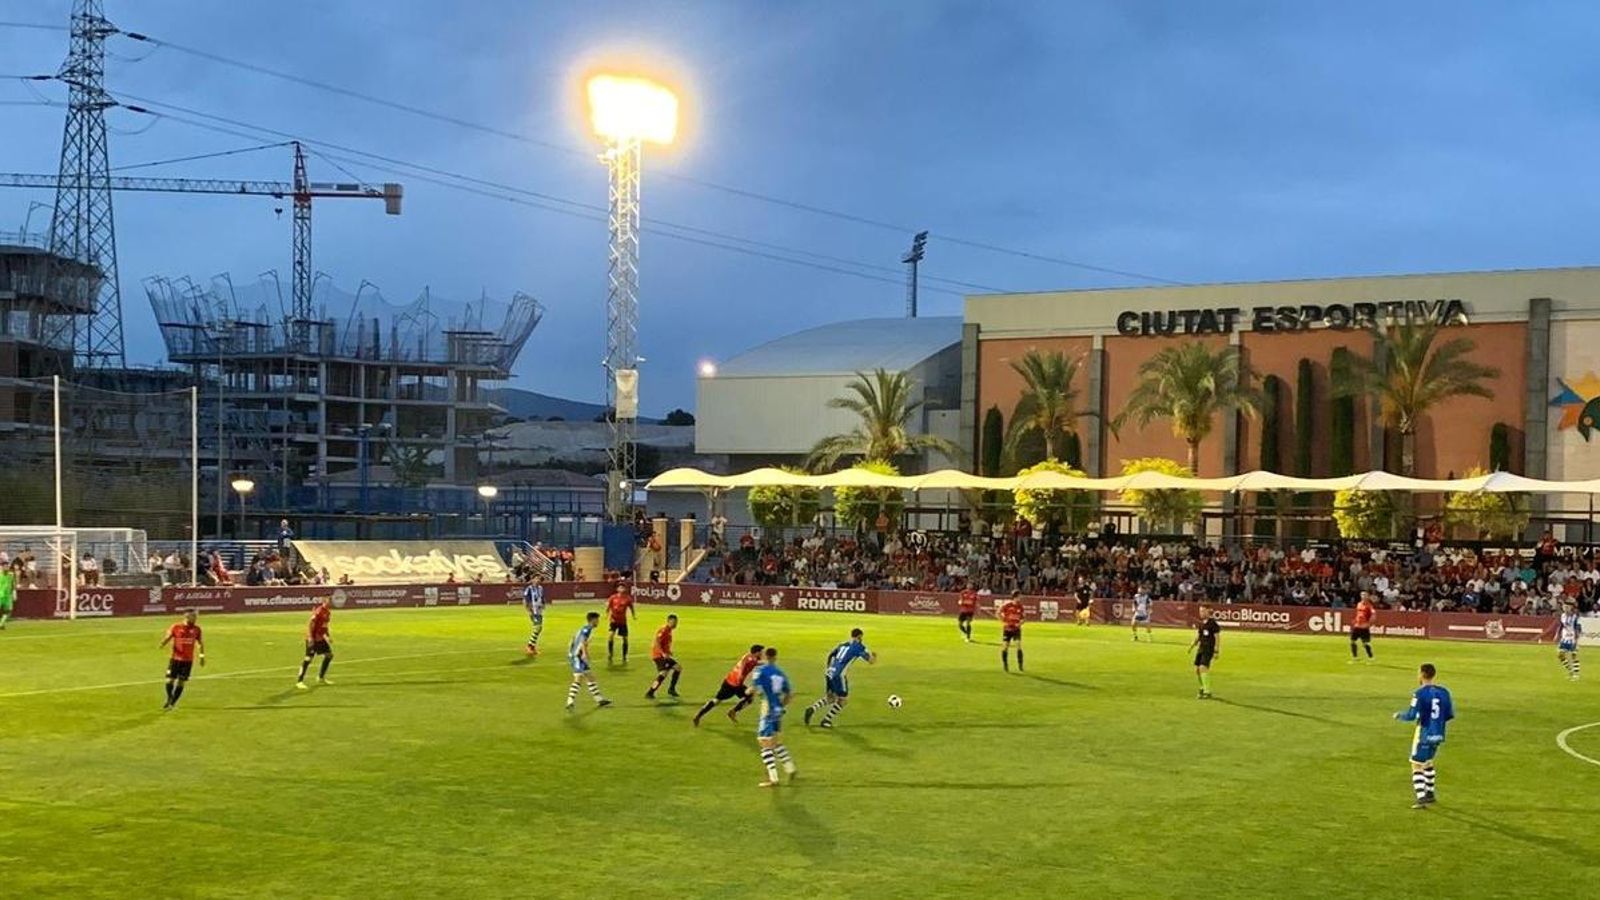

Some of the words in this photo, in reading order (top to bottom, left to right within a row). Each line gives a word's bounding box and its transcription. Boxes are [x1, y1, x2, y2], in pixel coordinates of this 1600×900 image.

[1116, 307, 1240, 337] CIUTAT
[1252, 299, 1470, 332] ESPORTIVA
[631, 586, 665, 598] ProLiga
[799, 591, 866, 600] TALLERES
[798, 598, 866, 611] ROMERO
[836, 645, 850, 660] 11
[1431, 698, 1440, 719] 5
